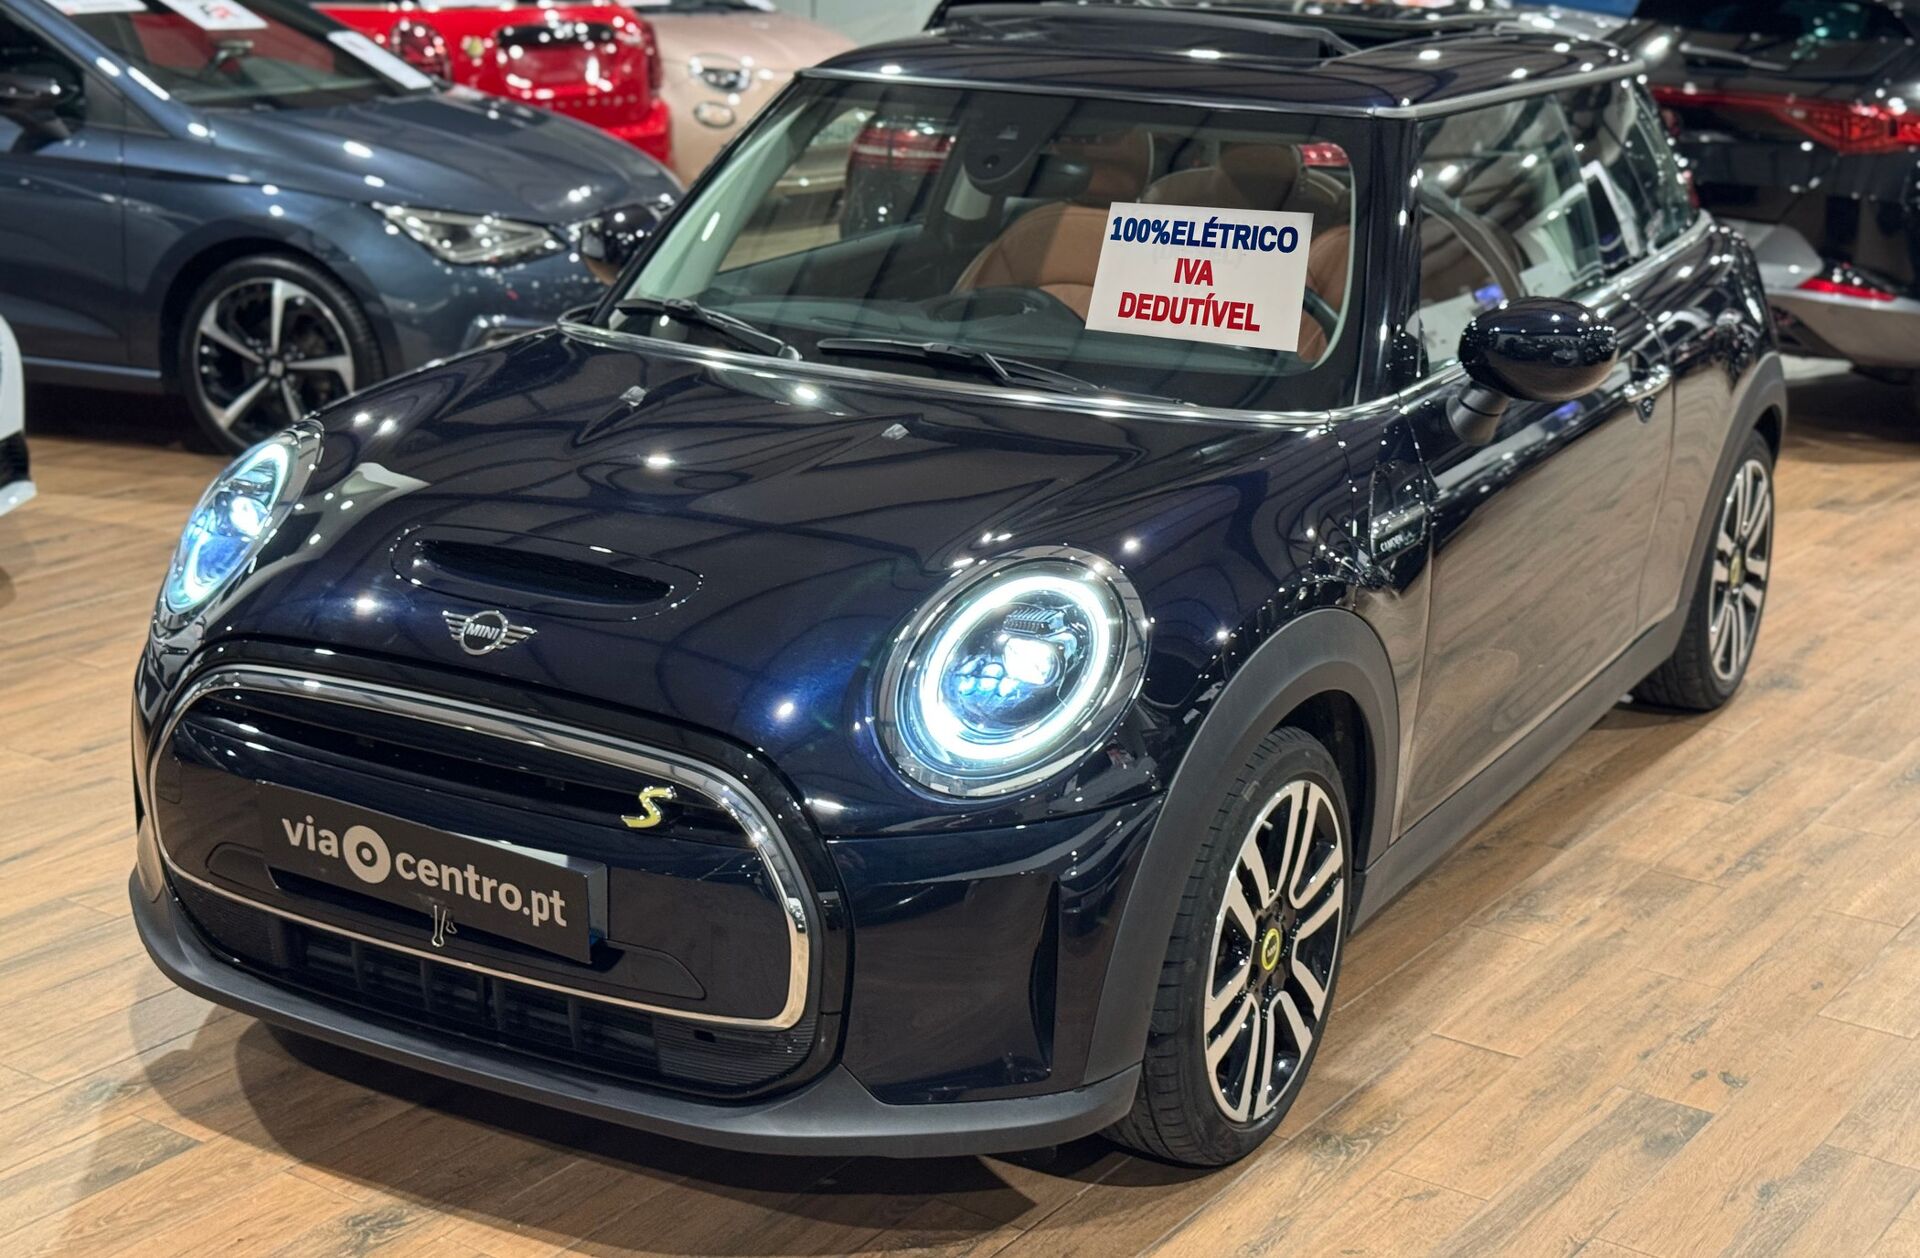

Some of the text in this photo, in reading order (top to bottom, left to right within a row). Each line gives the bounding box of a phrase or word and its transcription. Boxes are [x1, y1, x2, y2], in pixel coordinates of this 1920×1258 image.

[1173, 257, 1214, 287] IVA
[1117, 291, 1261, 332] DEDUTÍVEL
[466, 622, 501, 641] MINI
[621, 786, 677, 828] S
